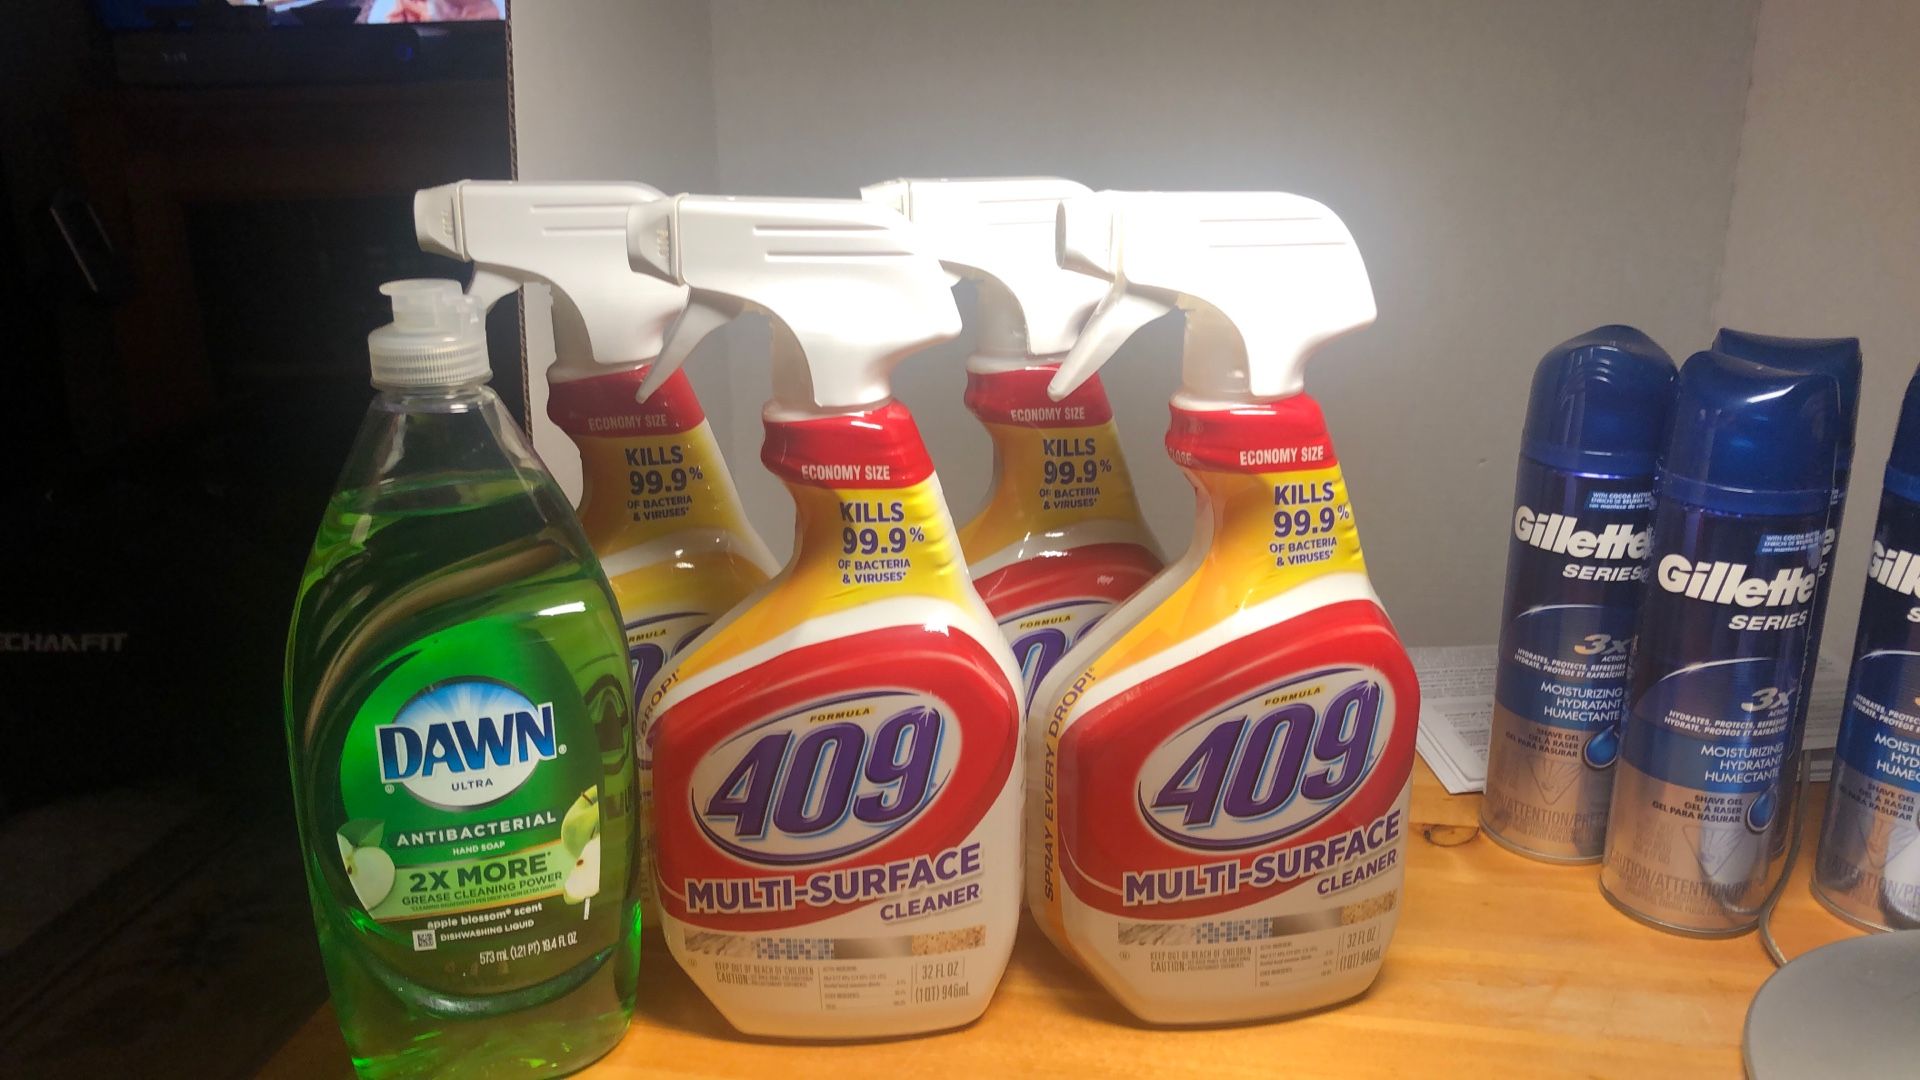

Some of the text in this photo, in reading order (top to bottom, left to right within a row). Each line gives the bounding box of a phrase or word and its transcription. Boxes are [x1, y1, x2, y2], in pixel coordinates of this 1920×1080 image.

[587, 413, 669, 432] ECONOMY SIZE
[1011, 406, 1086, 422] ECONOMY SIZE
[624, 445, 684, 467] KILLS
[1043, 438, 1096, 457] KILLS
[1240, 445, 1324, 467] ECONOMY SIZE
[629, 466, 704, 496] 99.9%
[801, 464, 890, 481] ECONOMY SIZE
[1044, 459, 1112, 485] 99.9%
[1039, 487, 1101, 499] OF BACTERIA
[1273, 482, 1335, 506] KILLS
[1608, 492, 1632, 500] COCOA
[627, 495, 693, 511] OF BACTERIA
[1043, 500, 1051, 511] &
[633, 510, 641, 522] &
[839, 502, 905, 523] KILLS
[1273, 503, 1350, 538] 99.9%
[842, 526, 925, 555] 99.9%
[1514, 505, 1655, 560] Gillette
[1783, 533, 1805, 541] COCOA
[1269, 536, 1338, 554] OF BACTERIA
[838, 558, 911, 571] OF BACTERIA
[1276, 556, 1285, 567] &
[1869, 540, 1920, 600] Gill
[842, 573, 851, 584] &
[1562, 564, 1643, 582] SERIES
[1657, 553, 1816, 608] Gillette
[1020, 615, 1071, 629] FORMULA
[1728, 610, 1808, 631] SERIES
[629, 628, 667, 643] RMULA
[1552, 659, 1588, 671] PROTECTS,
[1601, 655, 1627, 663] ACTION
[1577, 670, 1585, 678] ET
[1264, 686, 1321, 706] FORMULA
[1540, 681, 1623, 699] MOISTURIZING
[1556, 697, 1622, 710] HYDRATANT
[809, 707, 871, 723] FORMULA
[1543, 706, 1620, 722] HUMECTANTE
[1668, 710, 1712, 727] HYDRATES,
[1714, 720, 1754, 730] PROTECTS,
[1537, 727, 1563, 739] SHAVE
[1664, 716, 1701, 733] HYDRATE,
[1743, 728, 1751, 737] ET
[376, 702, 558, 783] DAWN
[1539, 743, 1578, 758] RASURAR
[1552, 740, 1579, 749] RASER
[1700, 743, 1784, 759] MOISTURIZING
[1150, 679, 1384, 830] 409
[1719, 754, 1782, 770] HYDRATANT
[704, 705, 945, 840] 409
[1704, 767, 1780, 784] HUMECTANTE
[451, 777, 494, 792] ULTRA
[1044, 744, 1056, 823] EVERY
[1683, 801, 1742, 815] GEL RASER
[1694, 795, 1743, 806] SHAVE GEL
[1883, 798, 1914, 812] RASER
[1652, 801, 1741, 823] GEL PARA RASURAR
[396, 811, 557, 847] ANTIBACTERIAL
[452, 840, 506, 856] HAND SOAP
[1125, 810, 1400, 904] MULTI-SURFACE
[1044, 828, 1055, 902] SPRAY
[1317, 848, 1397, 895] CLEANER
[409, 869, 451, 893] 2X
[686, 842, 982, 912] MULTI-SURFACE
[402, 893, 450, 906] GREASE
[454, 881, 516, 900] CLEANING
[519, 871, 563, 889] POWER
[880, 884, 981, 922] CLEANER
[427, 916, 458, 930] apple
[514, 902, 543, 917] scent
[440, 919, 535, 942] DISHWASHING LIQUID
[479, 949, 495, 966] 573
[527, 940, 540, 956] PT)
[558, 936, 567, 949] FL
[567, 931, 578, 946] OZ
[1346, 932, 1357, 949] 32
[921, 960, 959, 980] 32 FL OZ
